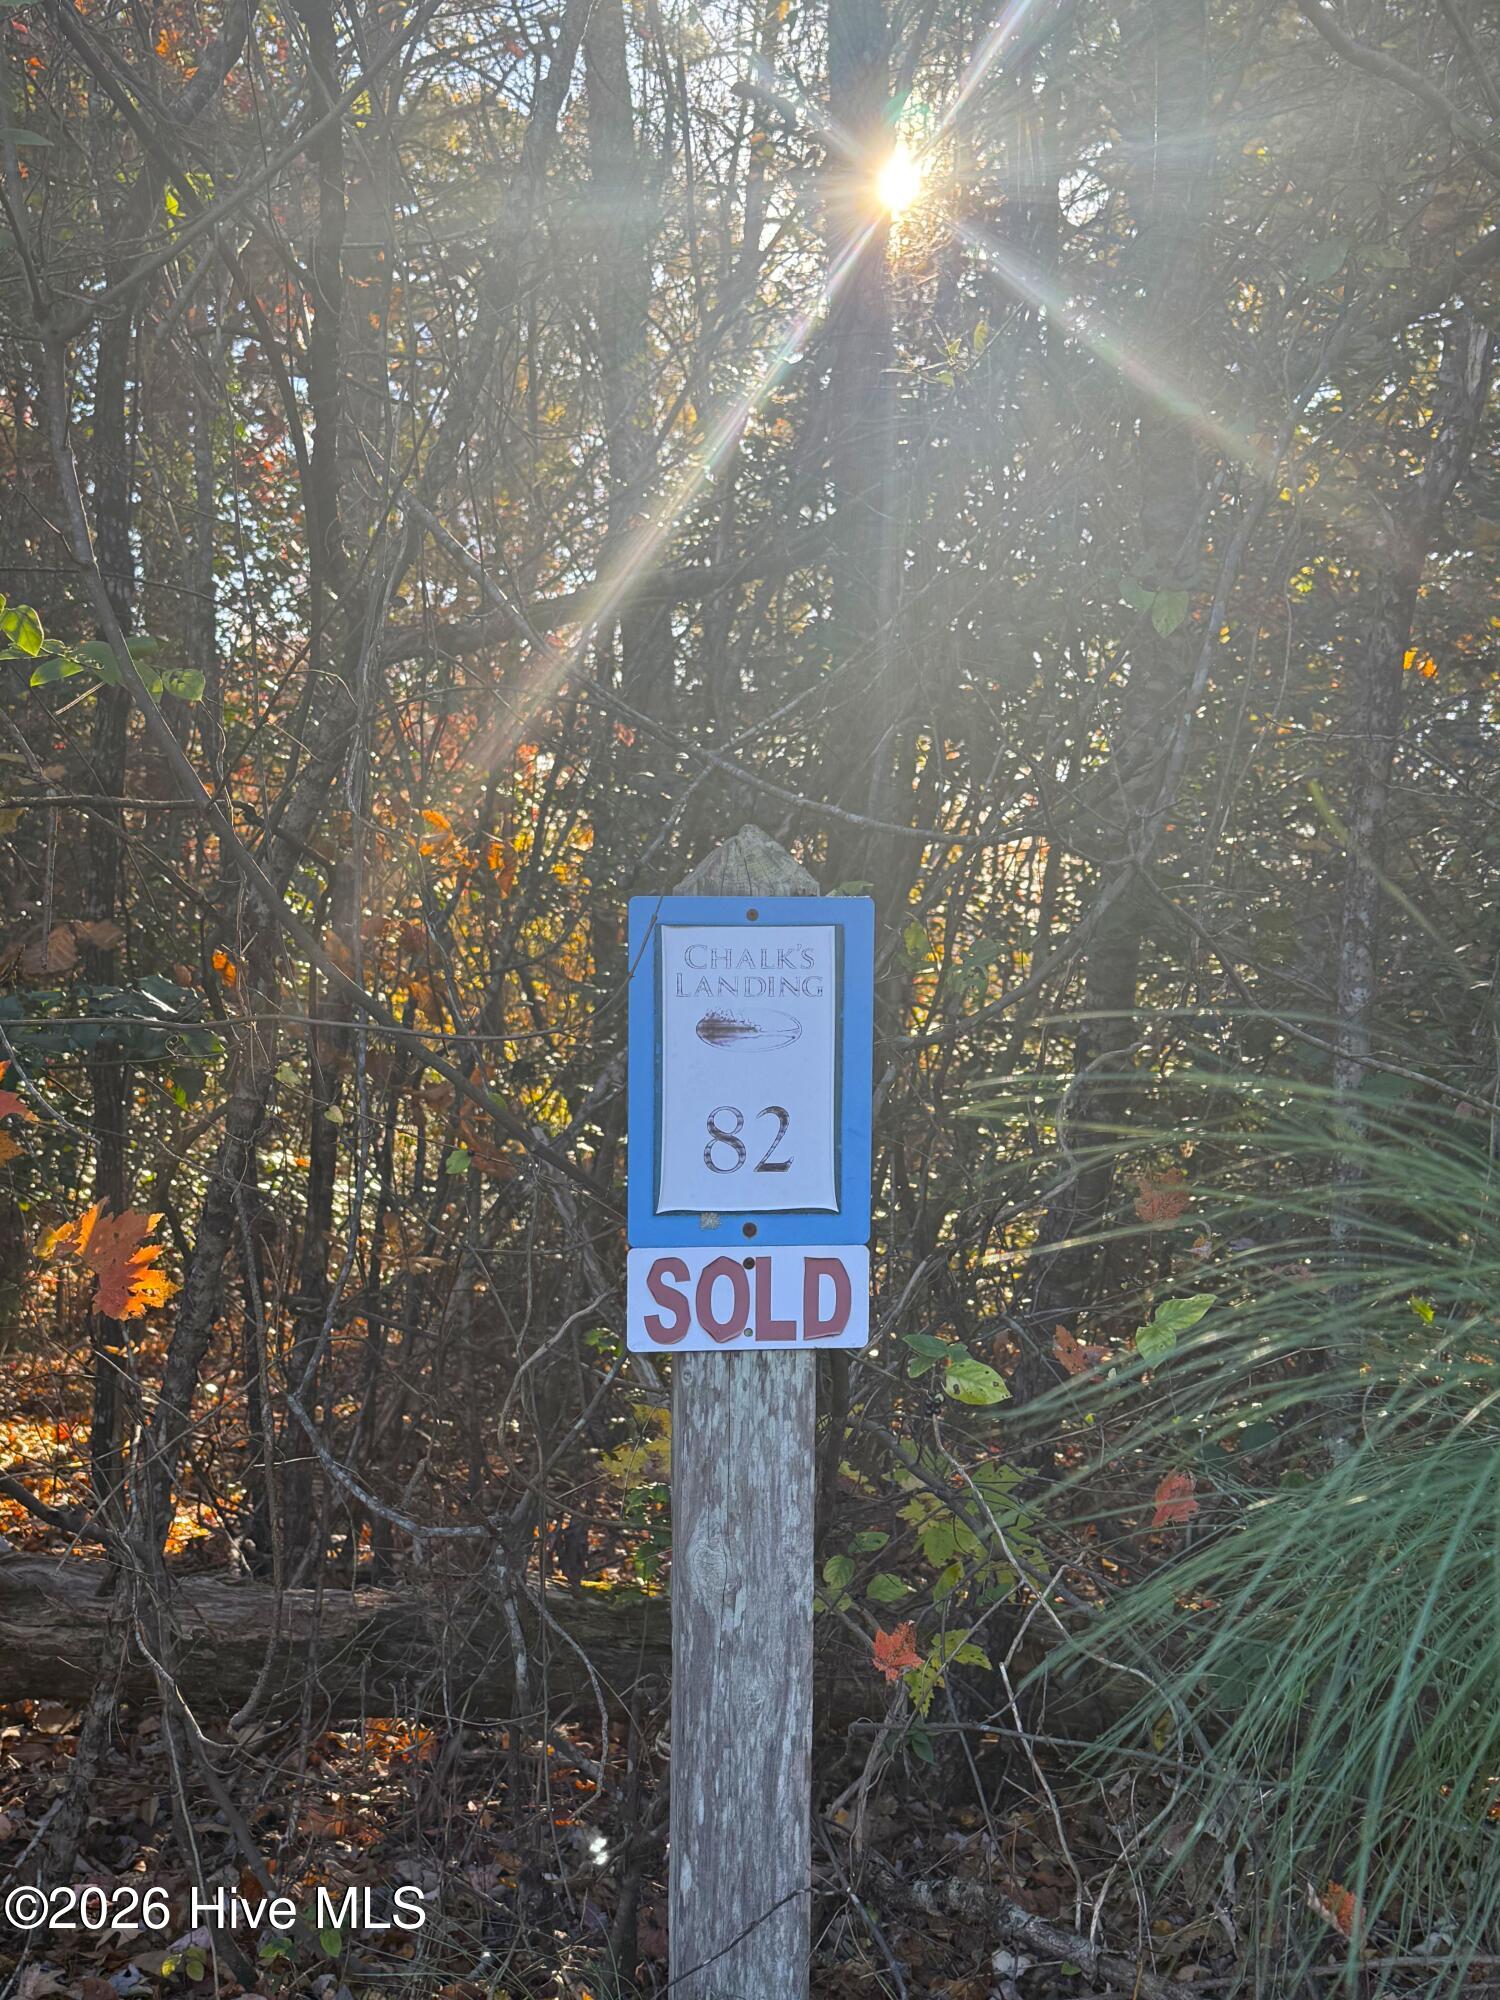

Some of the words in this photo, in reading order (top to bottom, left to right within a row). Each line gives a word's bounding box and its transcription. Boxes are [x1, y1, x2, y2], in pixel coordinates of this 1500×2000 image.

[684, 943, 815, 970] CHALK'S
[676, 973, 823, 998] LANDING
[703, 1105, 794, 1174] 82
[643, 1255, 852, 1345] SOLD
